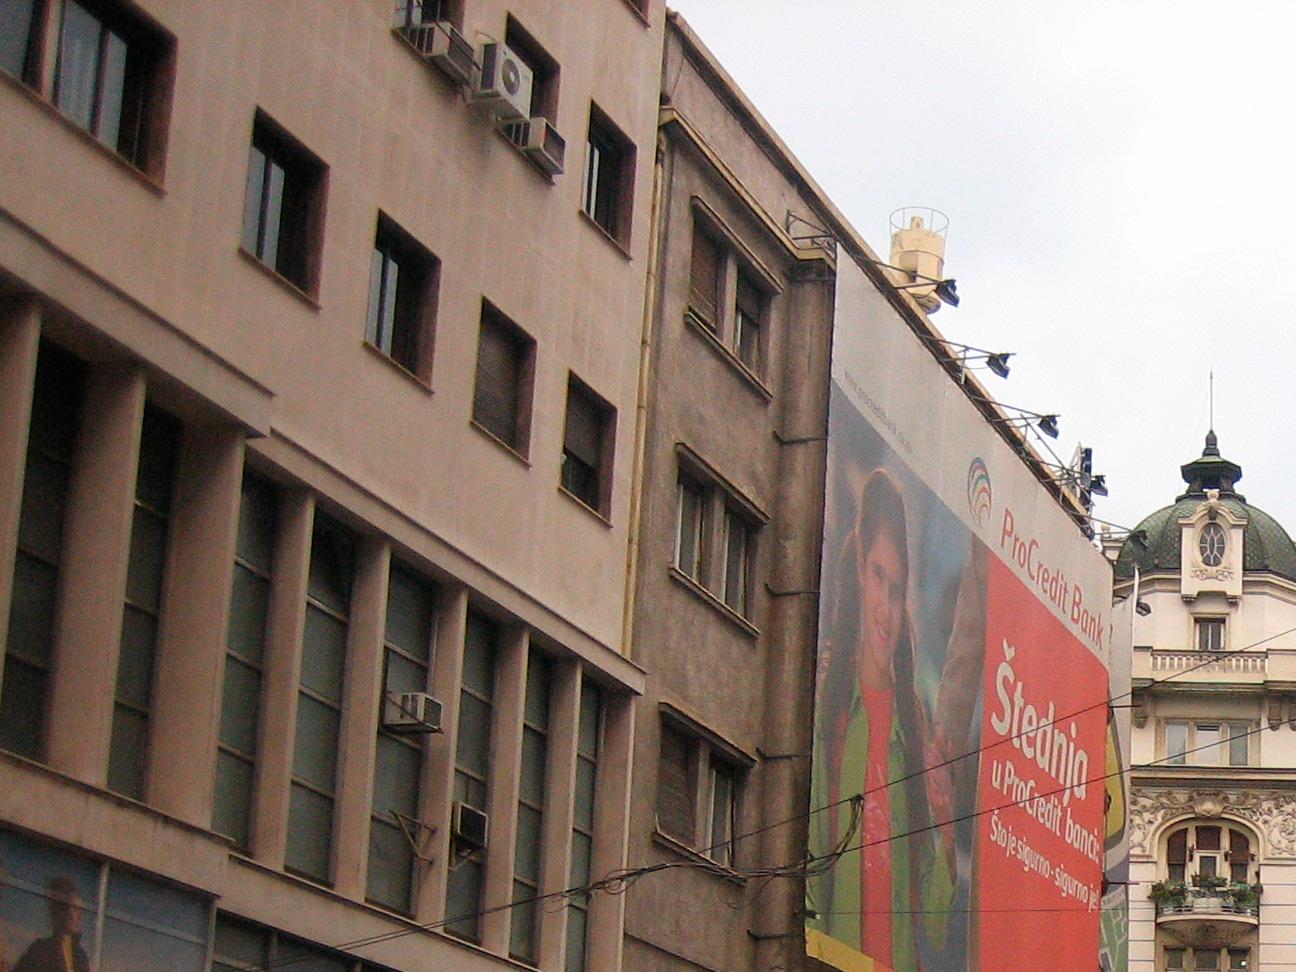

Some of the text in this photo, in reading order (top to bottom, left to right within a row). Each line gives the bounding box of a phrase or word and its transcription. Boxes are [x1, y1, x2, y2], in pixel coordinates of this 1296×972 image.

[1000, 507, 1104, 652] ProCredit Bank
[991, 637, 1090, 806] Štednja
[991, 759, 1002, 790] u
[1003, 759, 1064, 837] ProCredit
[1016, 835, 1051, 879] sigurno
